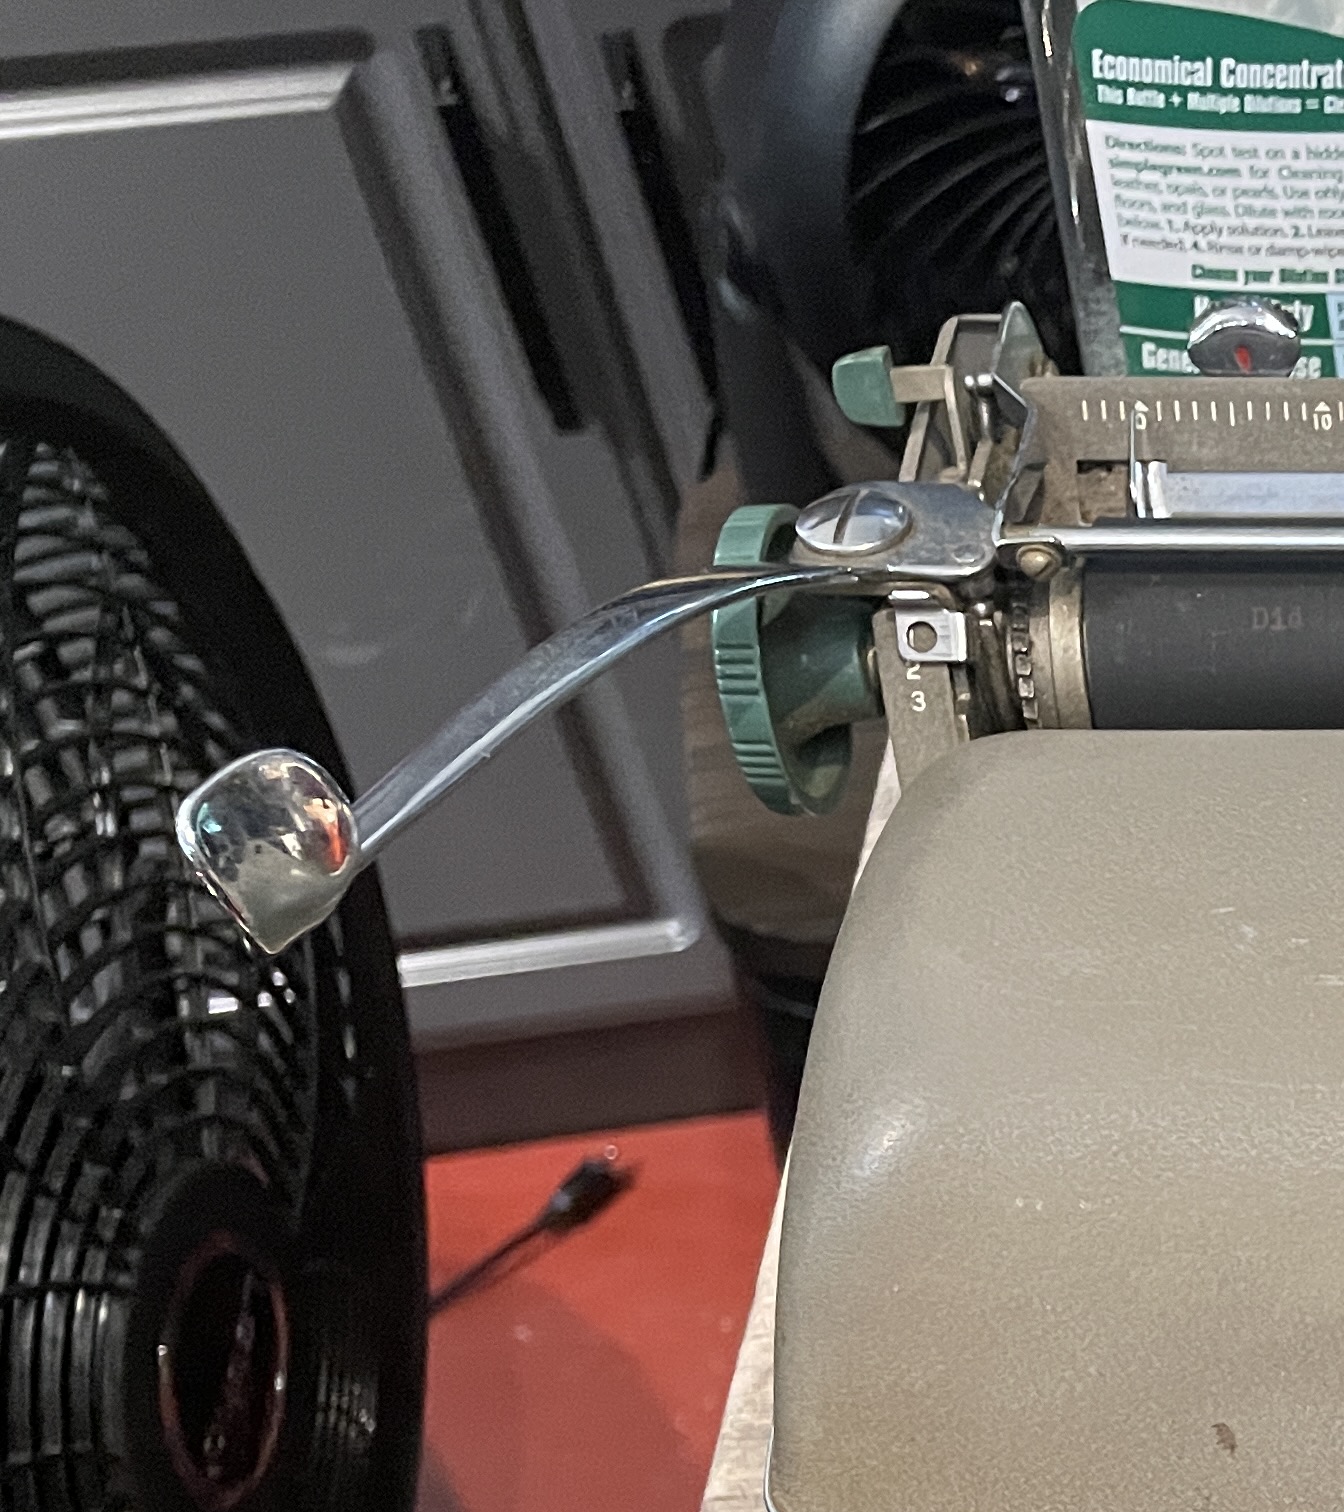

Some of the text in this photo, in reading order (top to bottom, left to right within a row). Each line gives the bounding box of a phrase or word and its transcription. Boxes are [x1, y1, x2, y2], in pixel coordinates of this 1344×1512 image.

[1091, 48, 1212, 87] Economical
[1126, 87, 1166, 109] Bottle
[1187, 91, 1241, 115] Multiple
[1192, 142, 1225, 161] Spot
[1230, 145, 1259, 159] test
[1265, 147, 1286, 160] on
[1278, 165, 1344, 184] Cleaning
[1312, 411, 1333, 432] 10
[910, 690, 927, 712] 3
